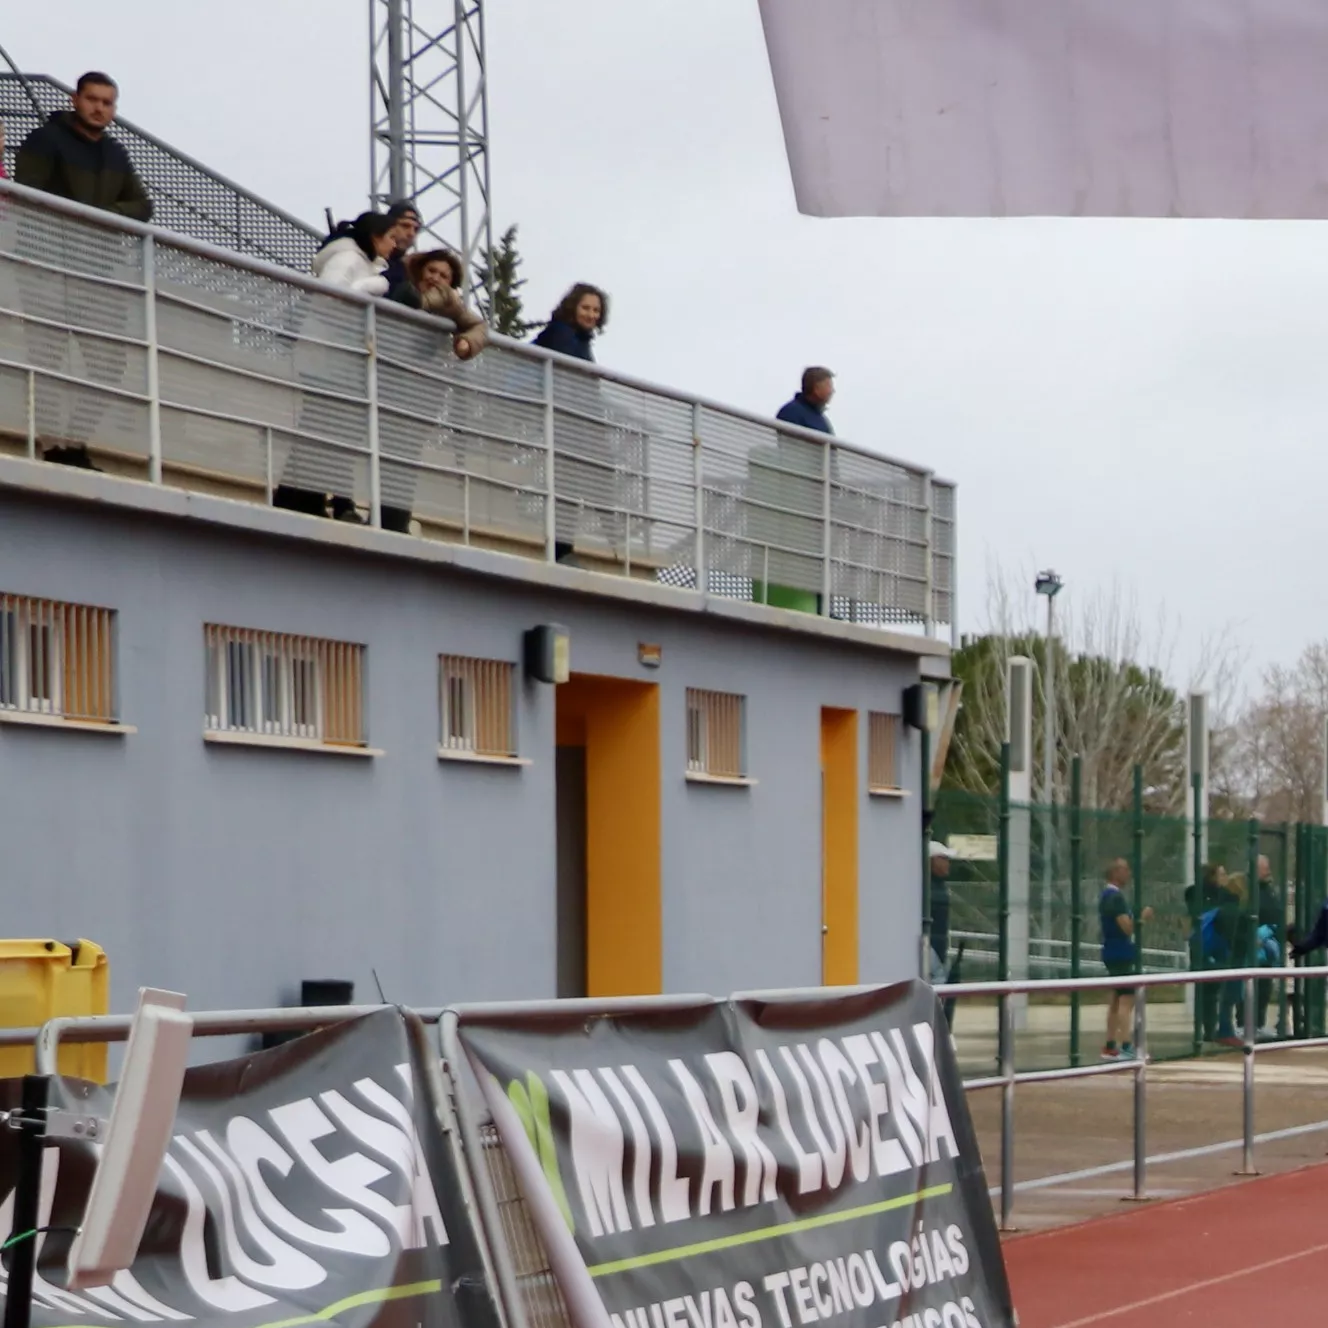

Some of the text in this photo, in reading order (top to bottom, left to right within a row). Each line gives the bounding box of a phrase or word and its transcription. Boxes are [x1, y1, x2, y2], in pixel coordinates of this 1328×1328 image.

[550, 1022, 960, 1237] MILAR LUCENA
[764, 1221, 970, 1328] TECNOLOGÍAS
